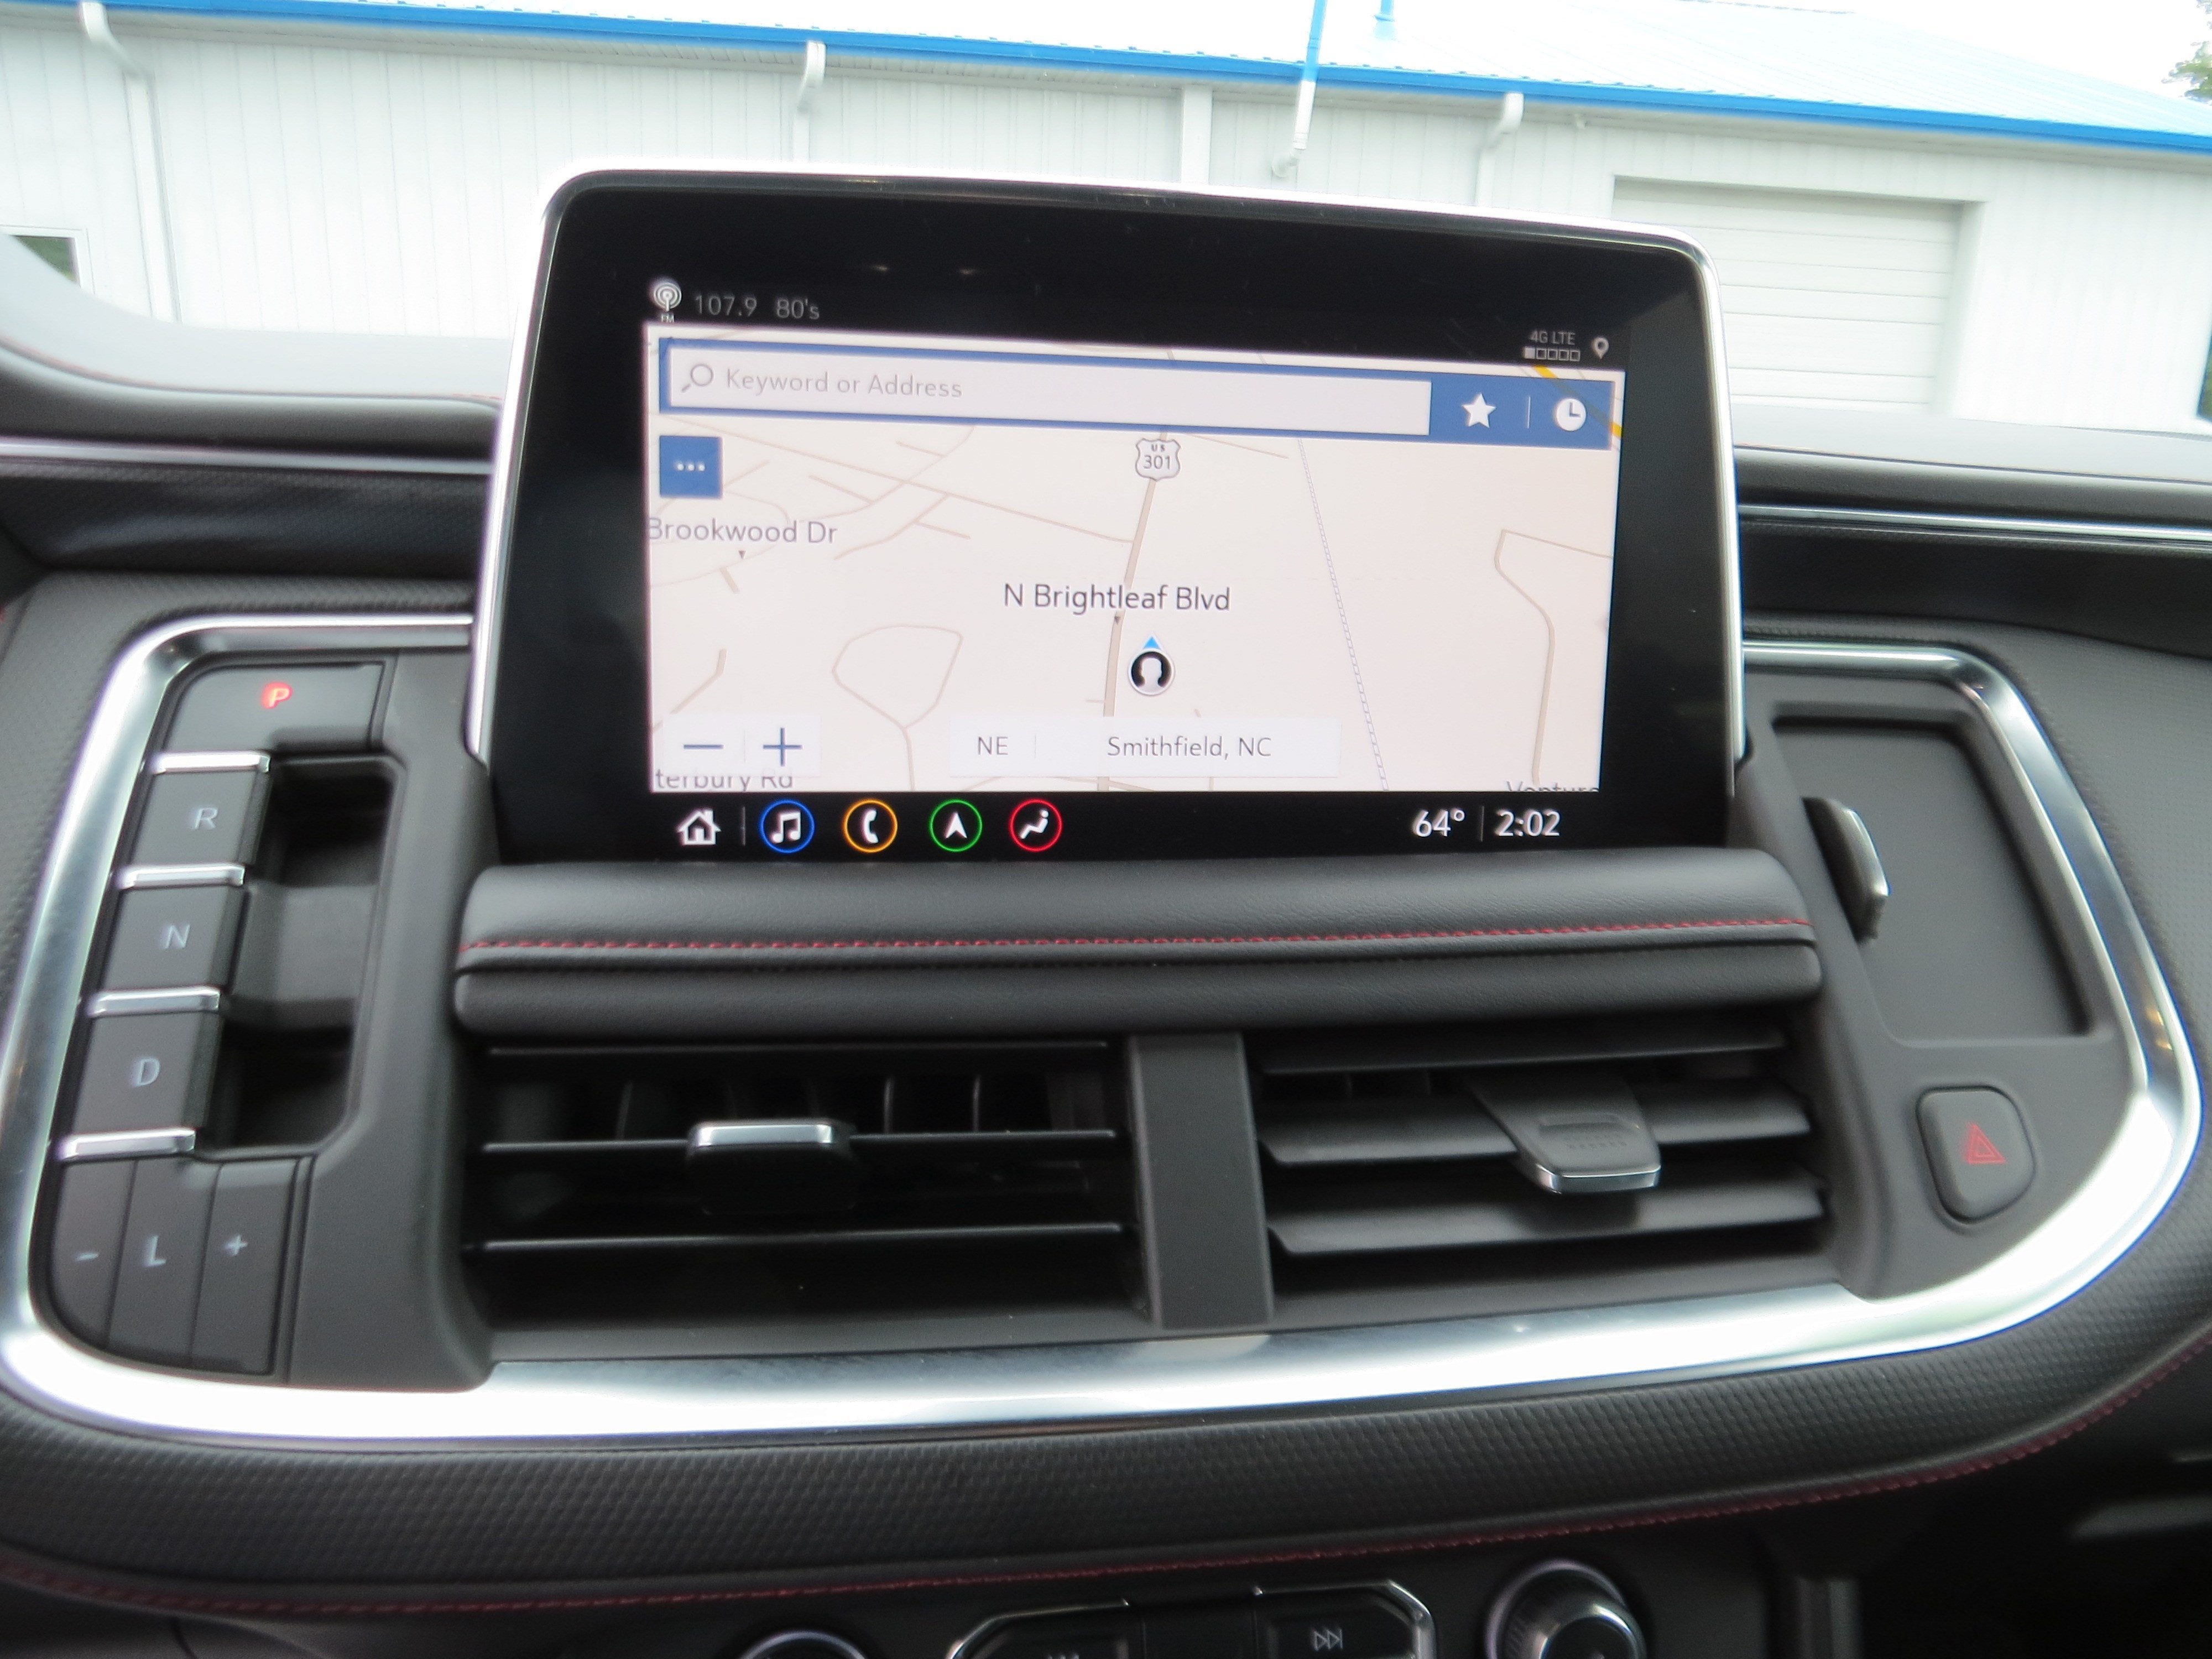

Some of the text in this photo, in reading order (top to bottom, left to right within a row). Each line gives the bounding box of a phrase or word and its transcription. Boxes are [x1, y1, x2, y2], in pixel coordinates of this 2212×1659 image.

[695, 294, 820, 320] 107.9 80's
[1529, 330, 1576, 345] 4G LTE
[726, 368, 963, 398] Keyword or Address
[1142, 455, 1170, 469] 301
[648, 517, 838, 543] Brookwood Dr
[1004, 582, 1230, 615] N Brightleaf Blvd
[261, 683, 292, 707] P
[977, 736, 1009, 756] NE
[1107, 735, 1272, 761] Smithfield, NC
[192, 807, 218, 831] R
[1495, 808, 1561, 837] 2:02
[163, 924, 191, 950] N
[132, 1057, 161, 1087] D
[144, 1237, 167, 1267] L
